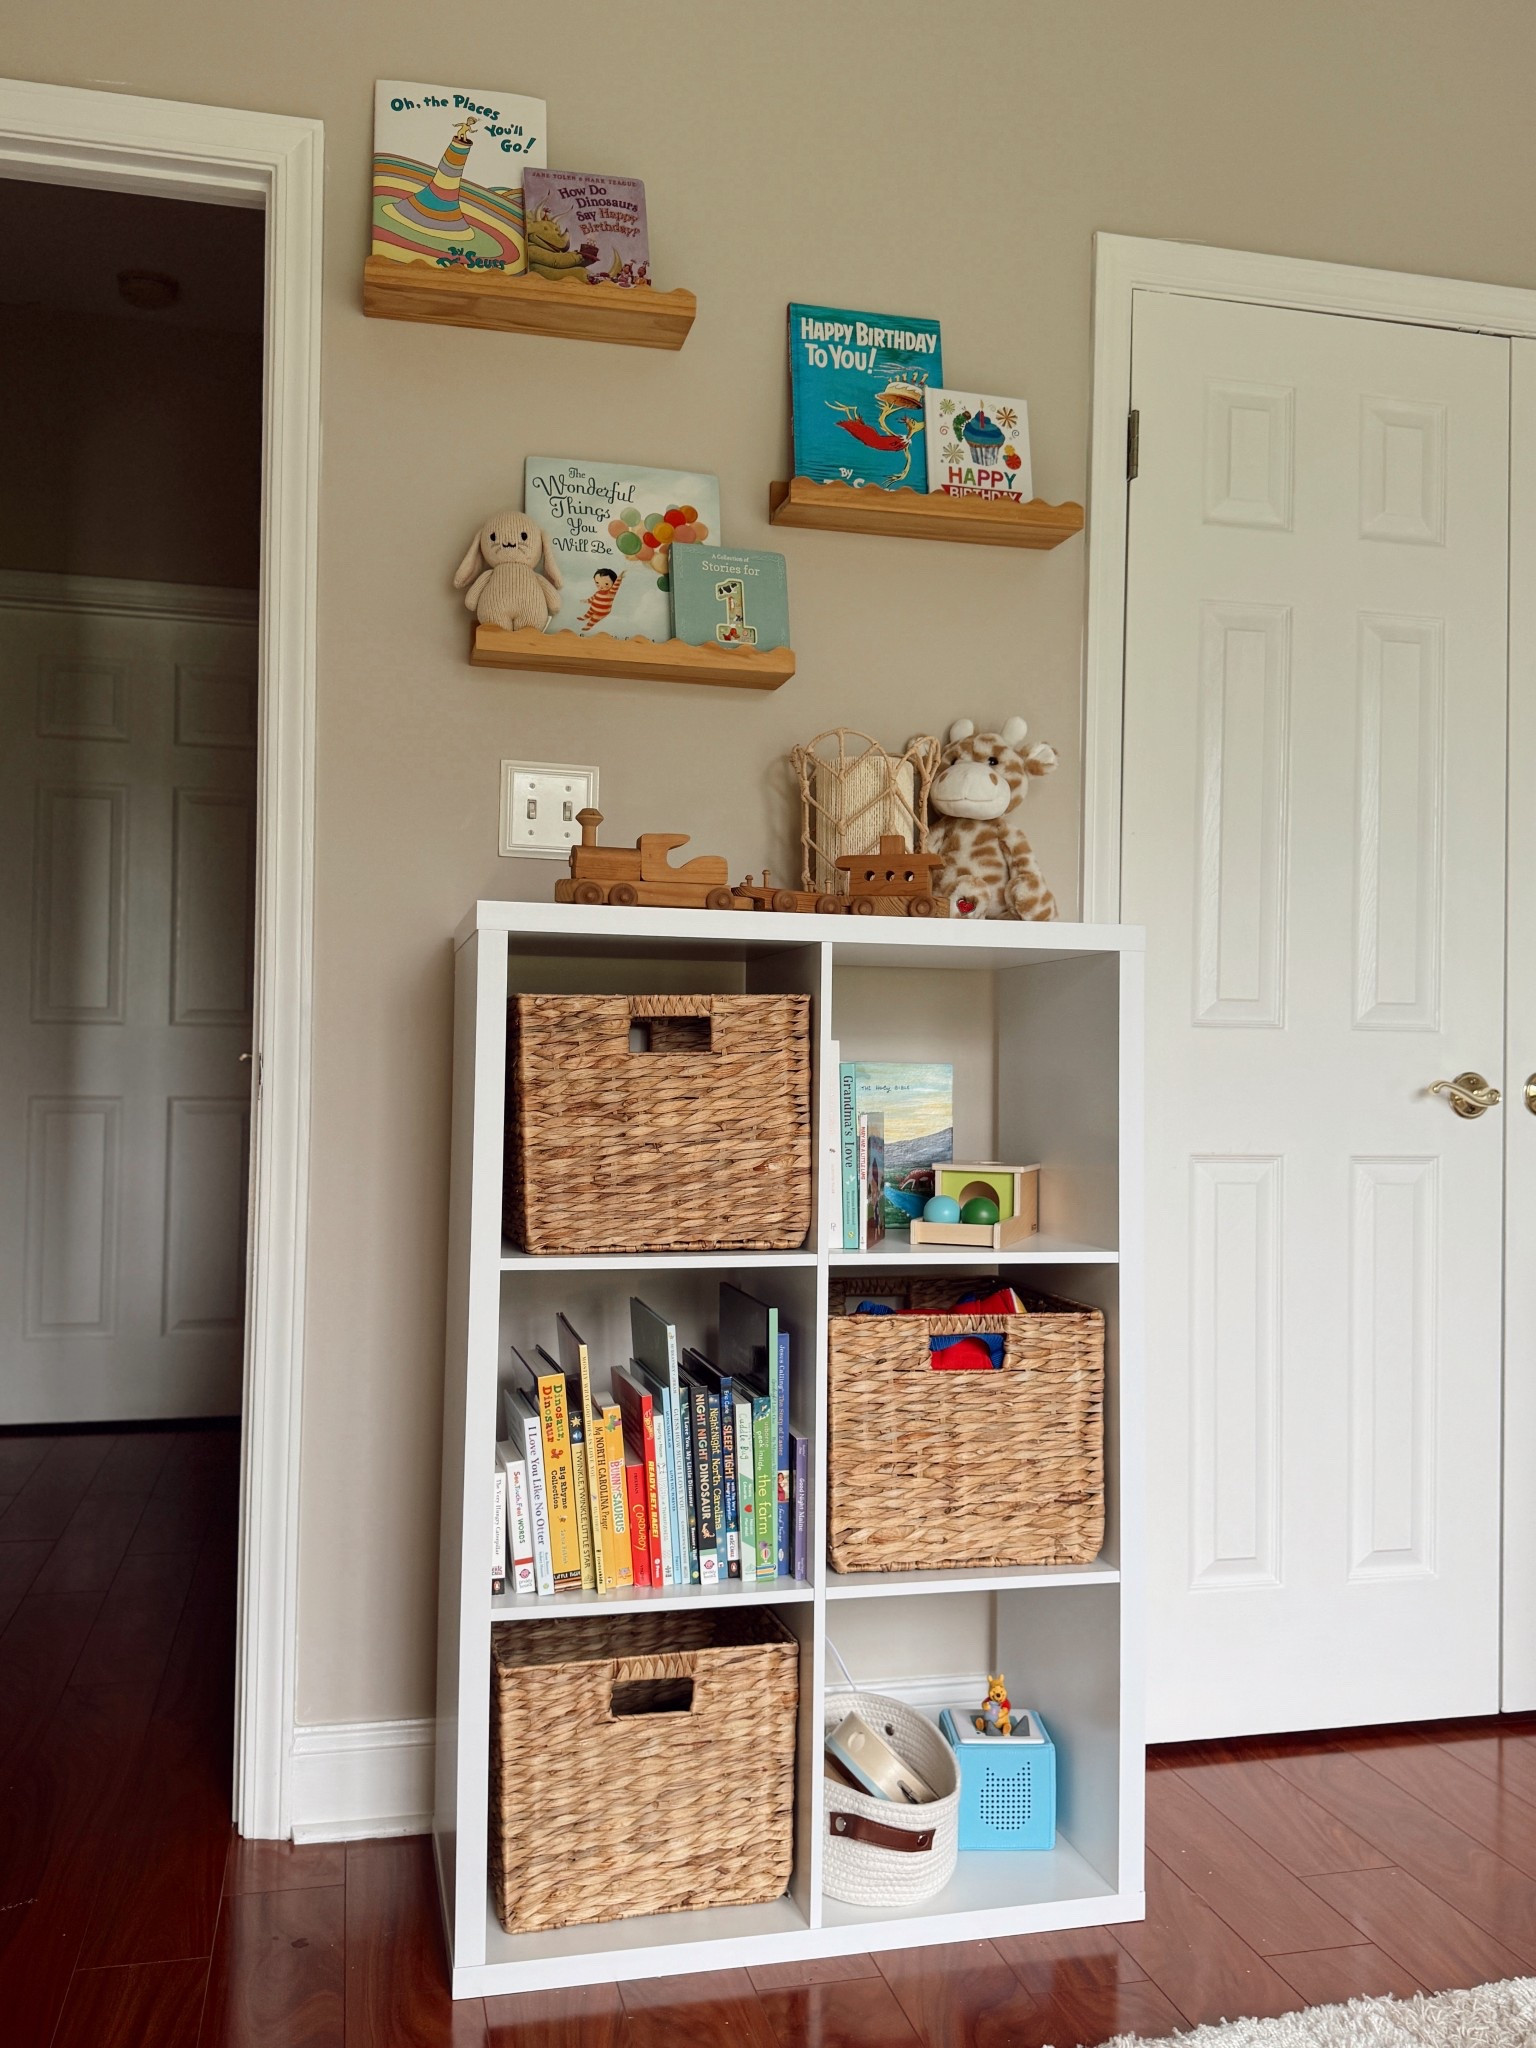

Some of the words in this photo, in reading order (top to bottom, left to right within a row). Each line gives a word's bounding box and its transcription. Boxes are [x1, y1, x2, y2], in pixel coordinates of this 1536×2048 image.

[391, 98, 421, 111] Oh,
[424, 96, 448, 107] the
[453, 95, 500, 120] Places
[484, 124, 523, 137] You'll
[501, 138, 536, 153] Go!
[558, 187, 586, 199] How
[588, 185, 606, 195] Do
[608, 179, 637, 187] TEAGUE
[576, 198, 638, 212] Dinosaurs
[576, 211, 597, 221] Say
[599, 208, 638, 225] Happy
[579, 221, 640, 237] Birthday?
[448, 247, 464, 256] By
[801, 317, 853, 345] HAPPY
[856, 322, 937, 354] BIRTHDAY
[828, 344, 877, 374] YOU!
[569, 467, 585, 478] The
[839, 467, 853, 479] By
[948, 466, 1016, 489] HAPPY
[532, 474, 635, 504] Wonderful
[550, 496, 610, 522] Things
[567, 518, 597, 536] You
[553, 538, 588, 552] Will
[591, 540, 614, 554] Be
[702, 560, 741, 574] Stories
[744, 564, 760, 576] for
[715, 578, 757, 645] 1
[843, 1076, 853, 1136] Grandma's
[845, 1142, 854, 1168] Love
[543, 1386, 554, 1443] Dinosaur
[553, 1384, 565, 1441] Dinosaur,
[695, 1394, 705, 1426] NIGHT
[593, 1427, 603, 1436] My
[698, 1428, 708, 1460] NIGHT
[723, 1425, 732, 1451] SLEEP
[529, 1434, 537, 1455] Love
[596, 1437, 606, 1469] NORTH
[685, 1451, 691, 1460] My
[740, 1447, 749, 1459] Bug
[531, 1458, 540, 1476] You
[558, 1466, 566, 1480] Big
[712, 1458, 722, 1486] North
[725, 1453, 734, 1480] TIGHT
[757, 1450, 765, 1471] inside
[533, 1479, 542, 1500] Like
[551, 1470, 559, 1509] Collection
[560, 1482, 568, 1509] Rhyme
[599, 1468, 609, 1510] CAROLINA
[609, 1460, 624, 1533] BUNNYSAURUS
[700, 1464, 711, 1519] DINOSAUR
[758, 1474, 771, 1496] the
[535, 1503, 544, 1516] No
[578, 1487, 586, 1524] TWINKLE,
[713, 1488, 723, 1530] Carolina
[759, 1501, 771, 1534] farm
[536, 1519, 545, 1545] Otter
[600, 1511, 608, 1531] Prayer
[632, 1504, 647, 1551] CORDUROY
[494, 1527, 502, 1555] Caterpillar
[581, 1524, 589, 1548] LITTLE
